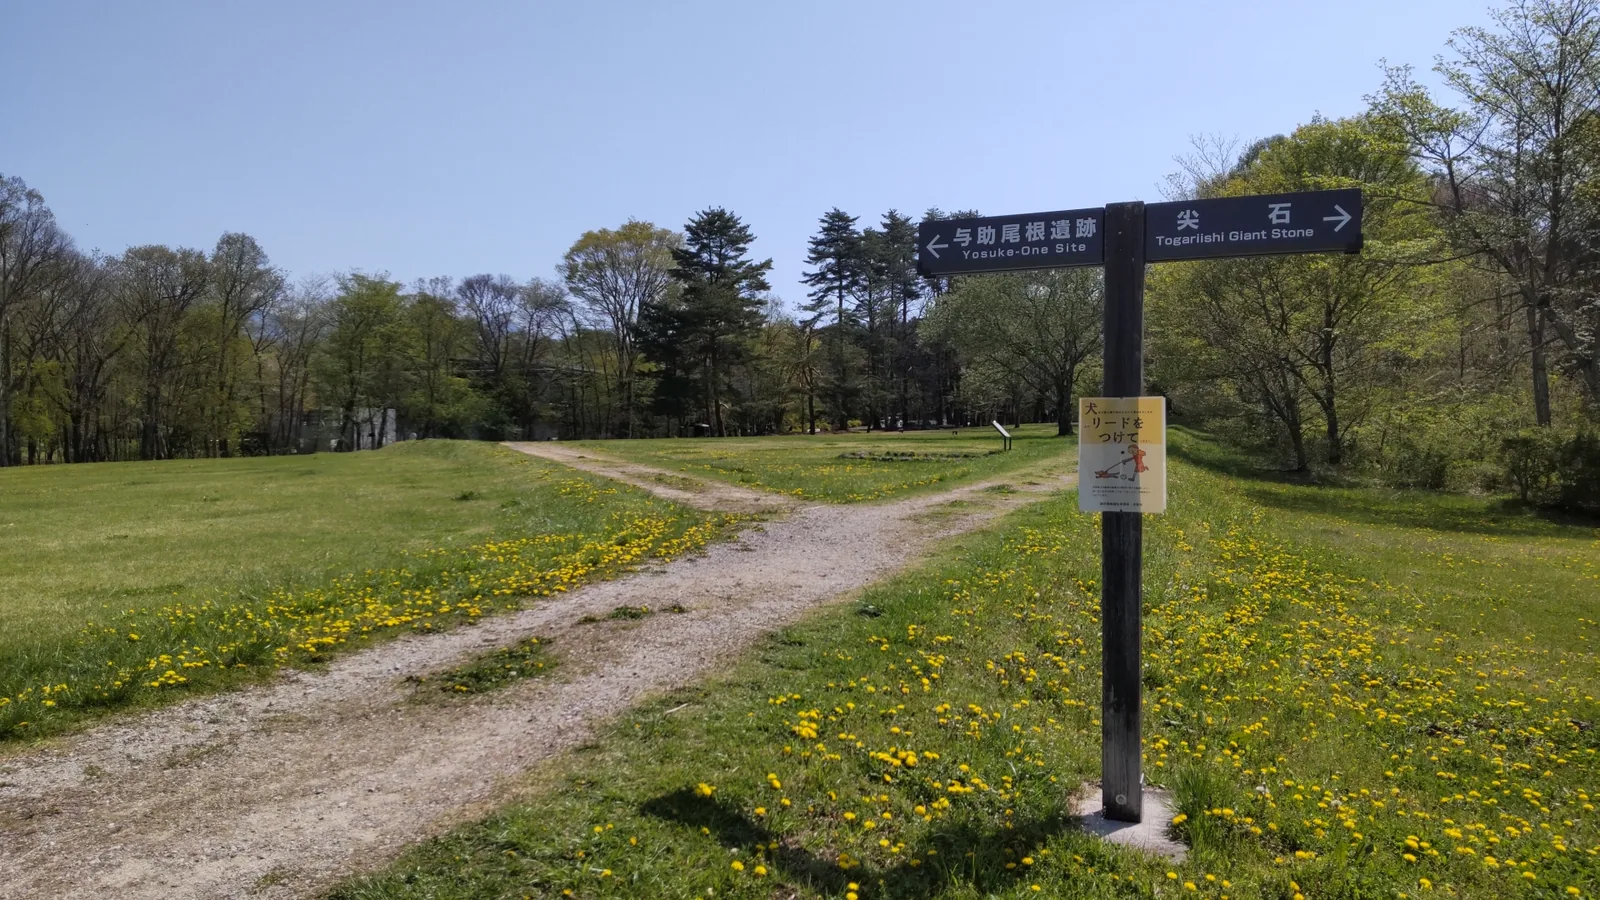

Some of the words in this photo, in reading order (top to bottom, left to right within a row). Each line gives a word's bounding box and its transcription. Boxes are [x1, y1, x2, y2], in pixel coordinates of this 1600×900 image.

[1176, 209, 1200, 231] 尖
[1268, 202, 1292, 225] 石
[953, 217, 1097, 247] 与助尾根遺跡
[1155, 231, 1225, 247] Togariishi
[1229, 229, 1268, 242] Giant
[1271, 228, 1314, 239] Stone
[962, 245, 1049, 260] Yosuke-One
[1055, 243, 1087, 253] Site
[1085, 402, 1098, 415] 犬
[1093, 417, 1144, 429] リードを
[1099, 431, 1139, 444] つけて
